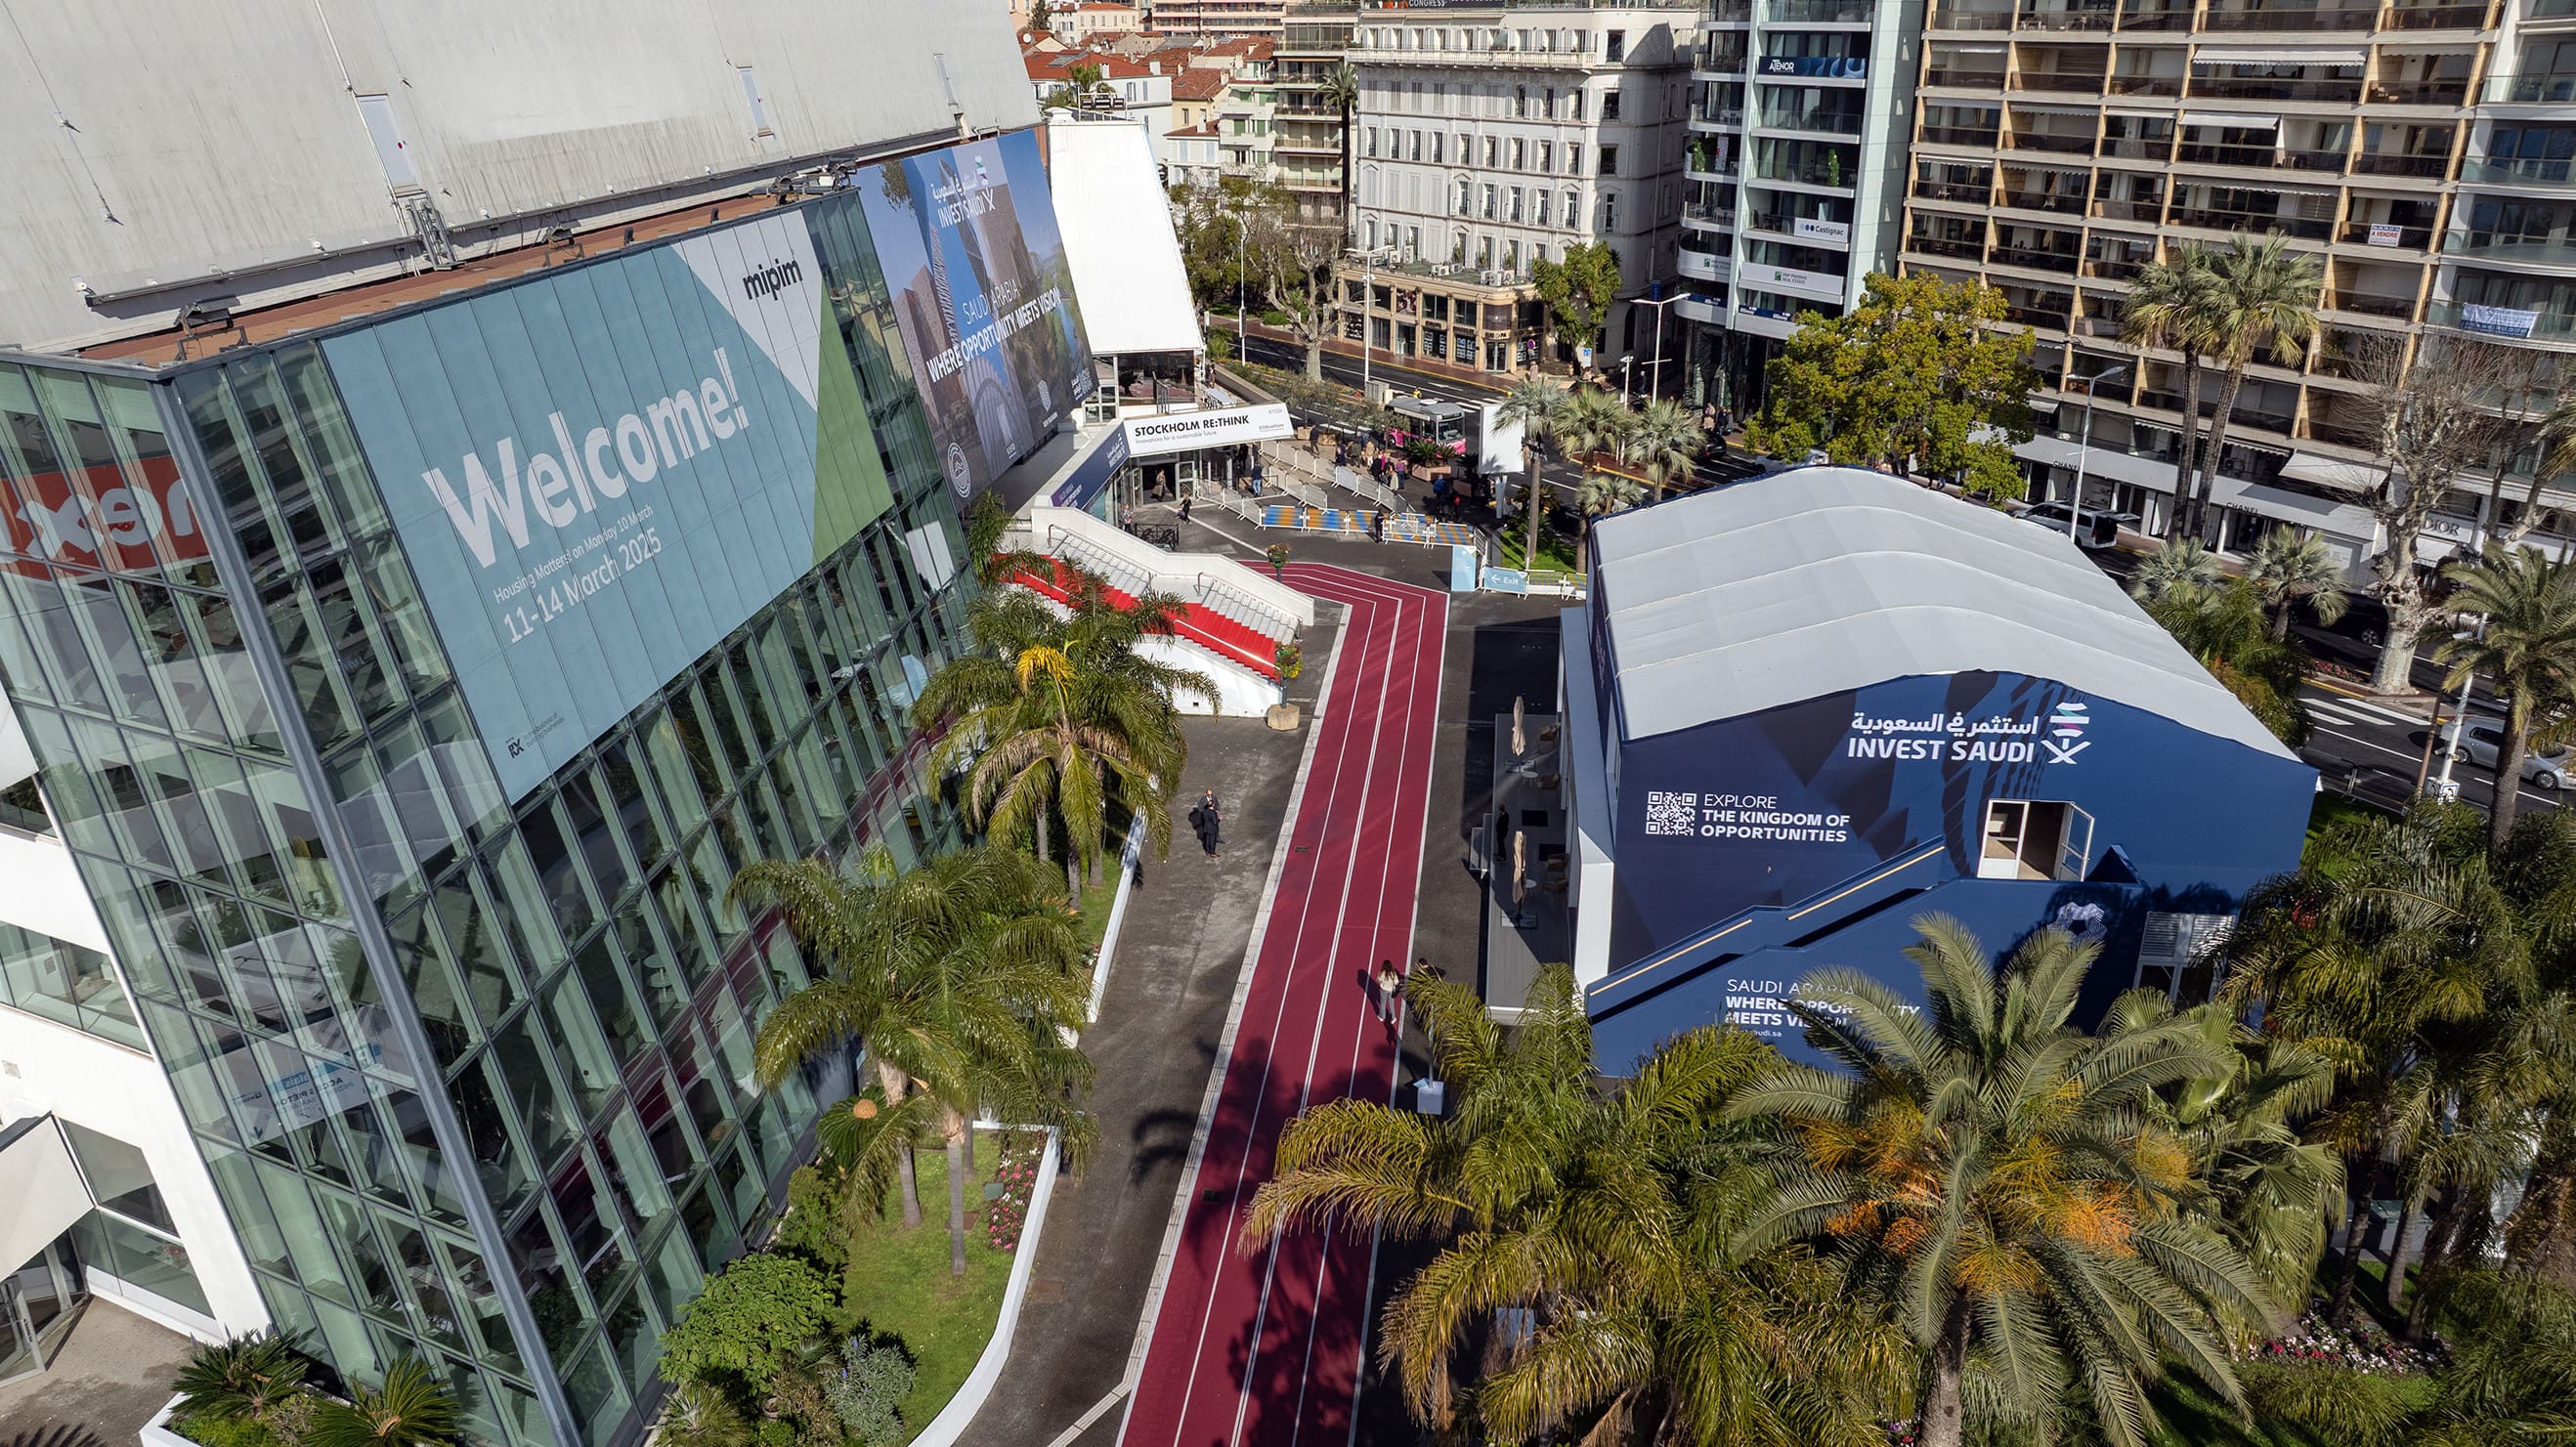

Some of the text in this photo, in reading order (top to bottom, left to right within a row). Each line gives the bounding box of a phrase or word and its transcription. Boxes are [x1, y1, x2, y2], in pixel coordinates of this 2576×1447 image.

[938, 194, 986, 229] INVEST SAUDI
[1815, 225, 1844, 236] Castignac
[743, 258, 802, 301] mipim
[963, 278, 1020, 325] SAUDI ARABIA
[926, 285, 1062, 383] WHERE OPPORTUNITY MEETS VISION
[1135, 420, 1200, 437] STOCKHOLM
[1203, 415, 1250, 429] RE:THINK
[422, 347, 750, 569] Welcome!
[2227, 501, 2258, 514] CHANEL
[2424, 518, 2460, 536] DIOR
[493, 503, 654, 604] Housing Matters! on Monday 10 March
[503, 527, 662, 643] 11-14 March 2025
[1503, 576, 1519, 585] Exit
[1851, 711, 2039, 738] استثمر في السعودية
[1848, 738, 2035, 763] INVEST SAUDI
[1704, 793, 1778, 809] EXPLORE
[1702, 809, 1850, 828] THE KINGDOM OF
[1700, 825, 1847, 842] OPPORTUNITIES
[1727, 978, 1782, 995] SAUDI
[1726, 996, 1789, 1011] WHERE
[1725, 1010, 1782, 1026] MEETS
